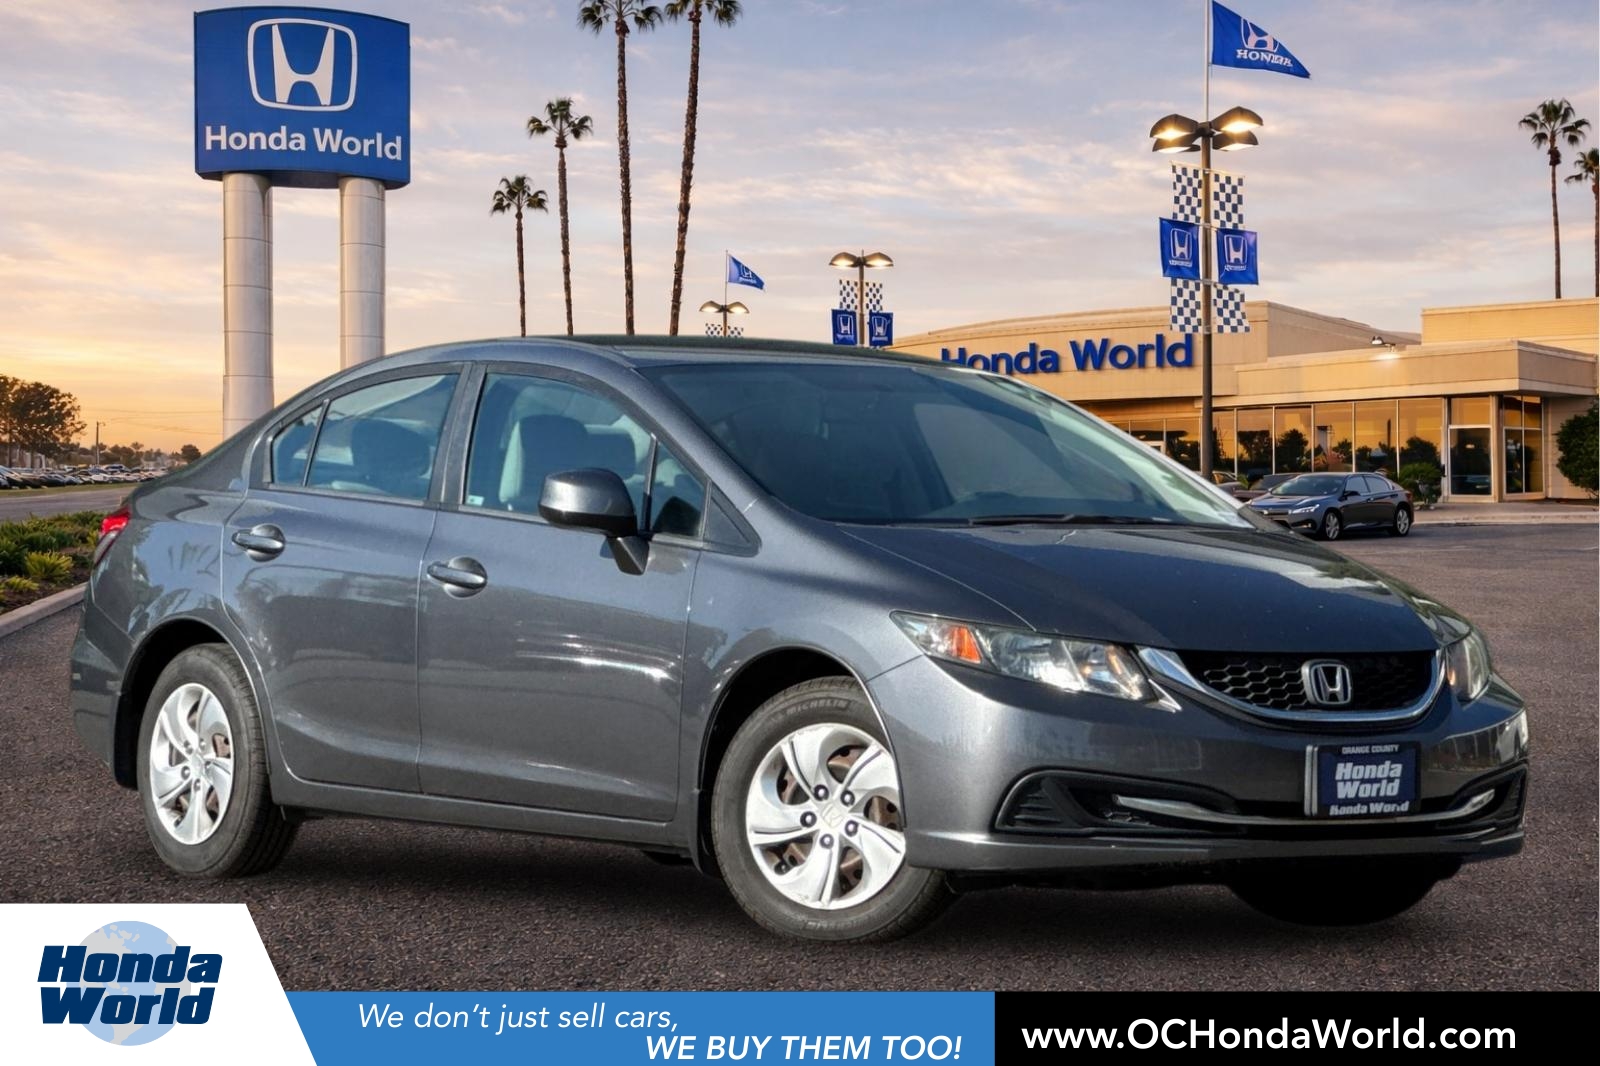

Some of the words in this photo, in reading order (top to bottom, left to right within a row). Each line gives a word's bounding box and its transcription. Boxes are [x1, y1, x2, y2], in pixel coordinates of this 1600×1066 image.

[205, 125, 306, 151] Honda
[313, 127, 402, 160] World
[941, 342, 1059, 375] Honda
[1069, 333, 1193, 371] World
[1371, 744, 1400, 754] COUNTY
[1335, 760, 1403, 781] Honda
[1336, 778, 1400, 799] World
